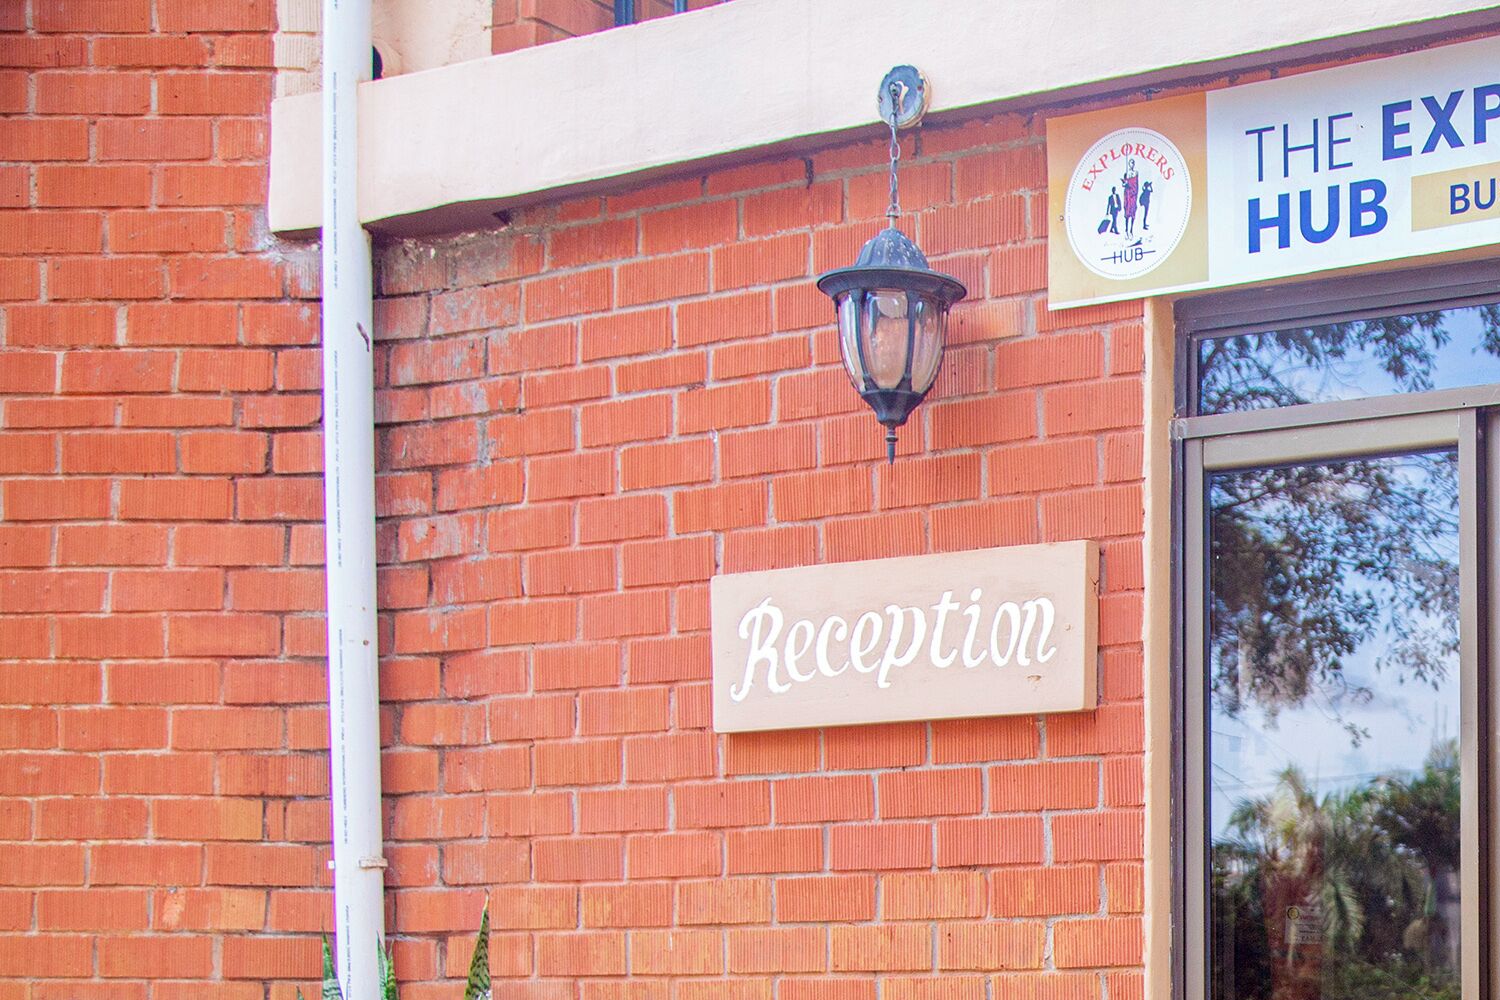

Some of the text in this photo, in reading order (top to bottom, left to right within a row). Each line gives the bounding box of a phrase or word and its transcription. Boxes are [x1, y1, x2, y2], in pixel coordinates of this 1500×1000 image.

[1082, 143, 1175, 192] EXPLORERS
[1246, 110, 1354, 183] THE
[1248, 178, 1389, 254] HUB
[1113, 247, 1144, 264] HUB
[730, 587, 1057, 702] Reception
